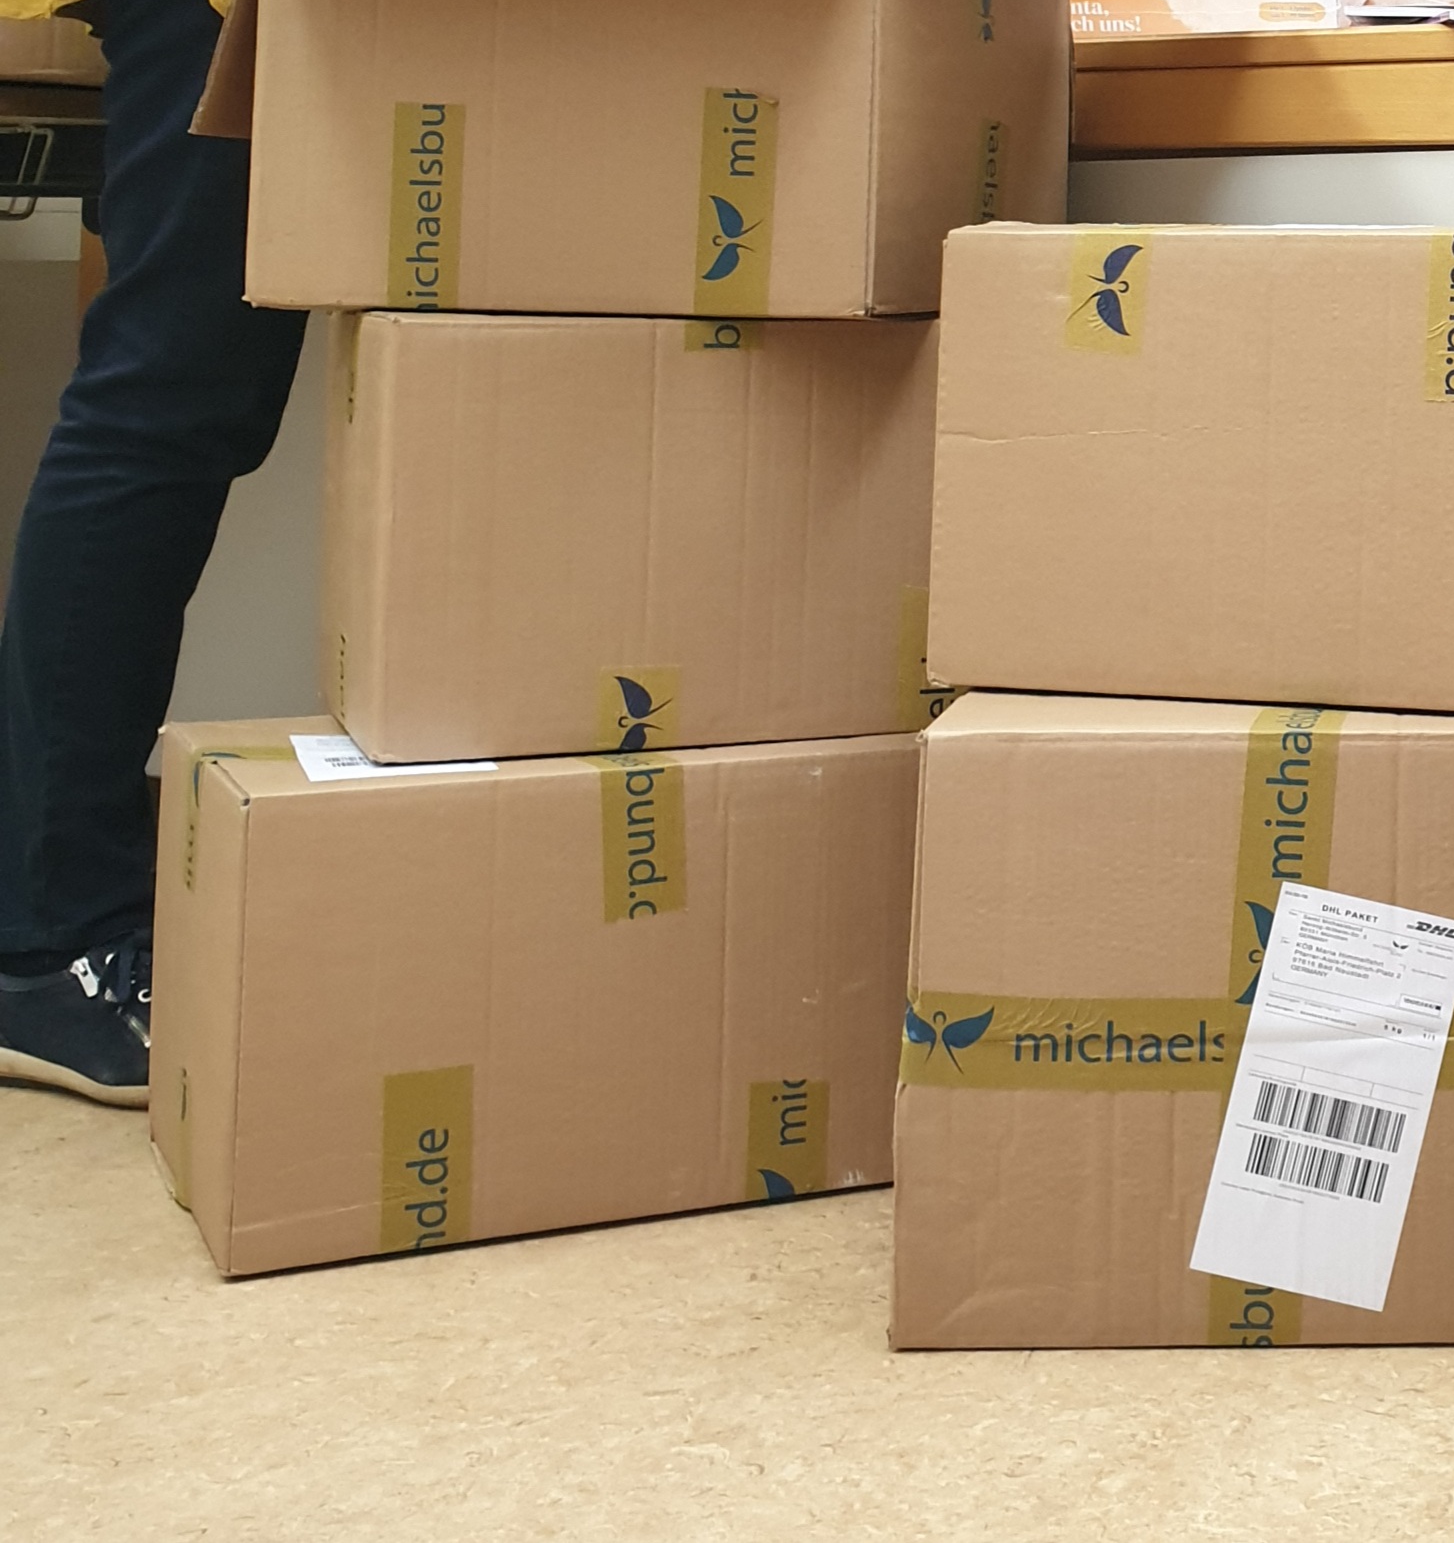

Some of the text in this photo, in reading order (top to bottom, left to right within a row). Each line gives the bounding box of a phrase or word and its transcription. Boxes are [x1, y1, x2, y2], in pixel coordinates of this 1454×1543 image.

[1100, 16, 1142, 32] uns!
[1322, 904, 1379, 924] DHL PAKET
[1315, 946, 1337, 957] Maria
[1291, 964, 1328, 978] GERMANY
[1318, 961, 1333, 972] Bad
